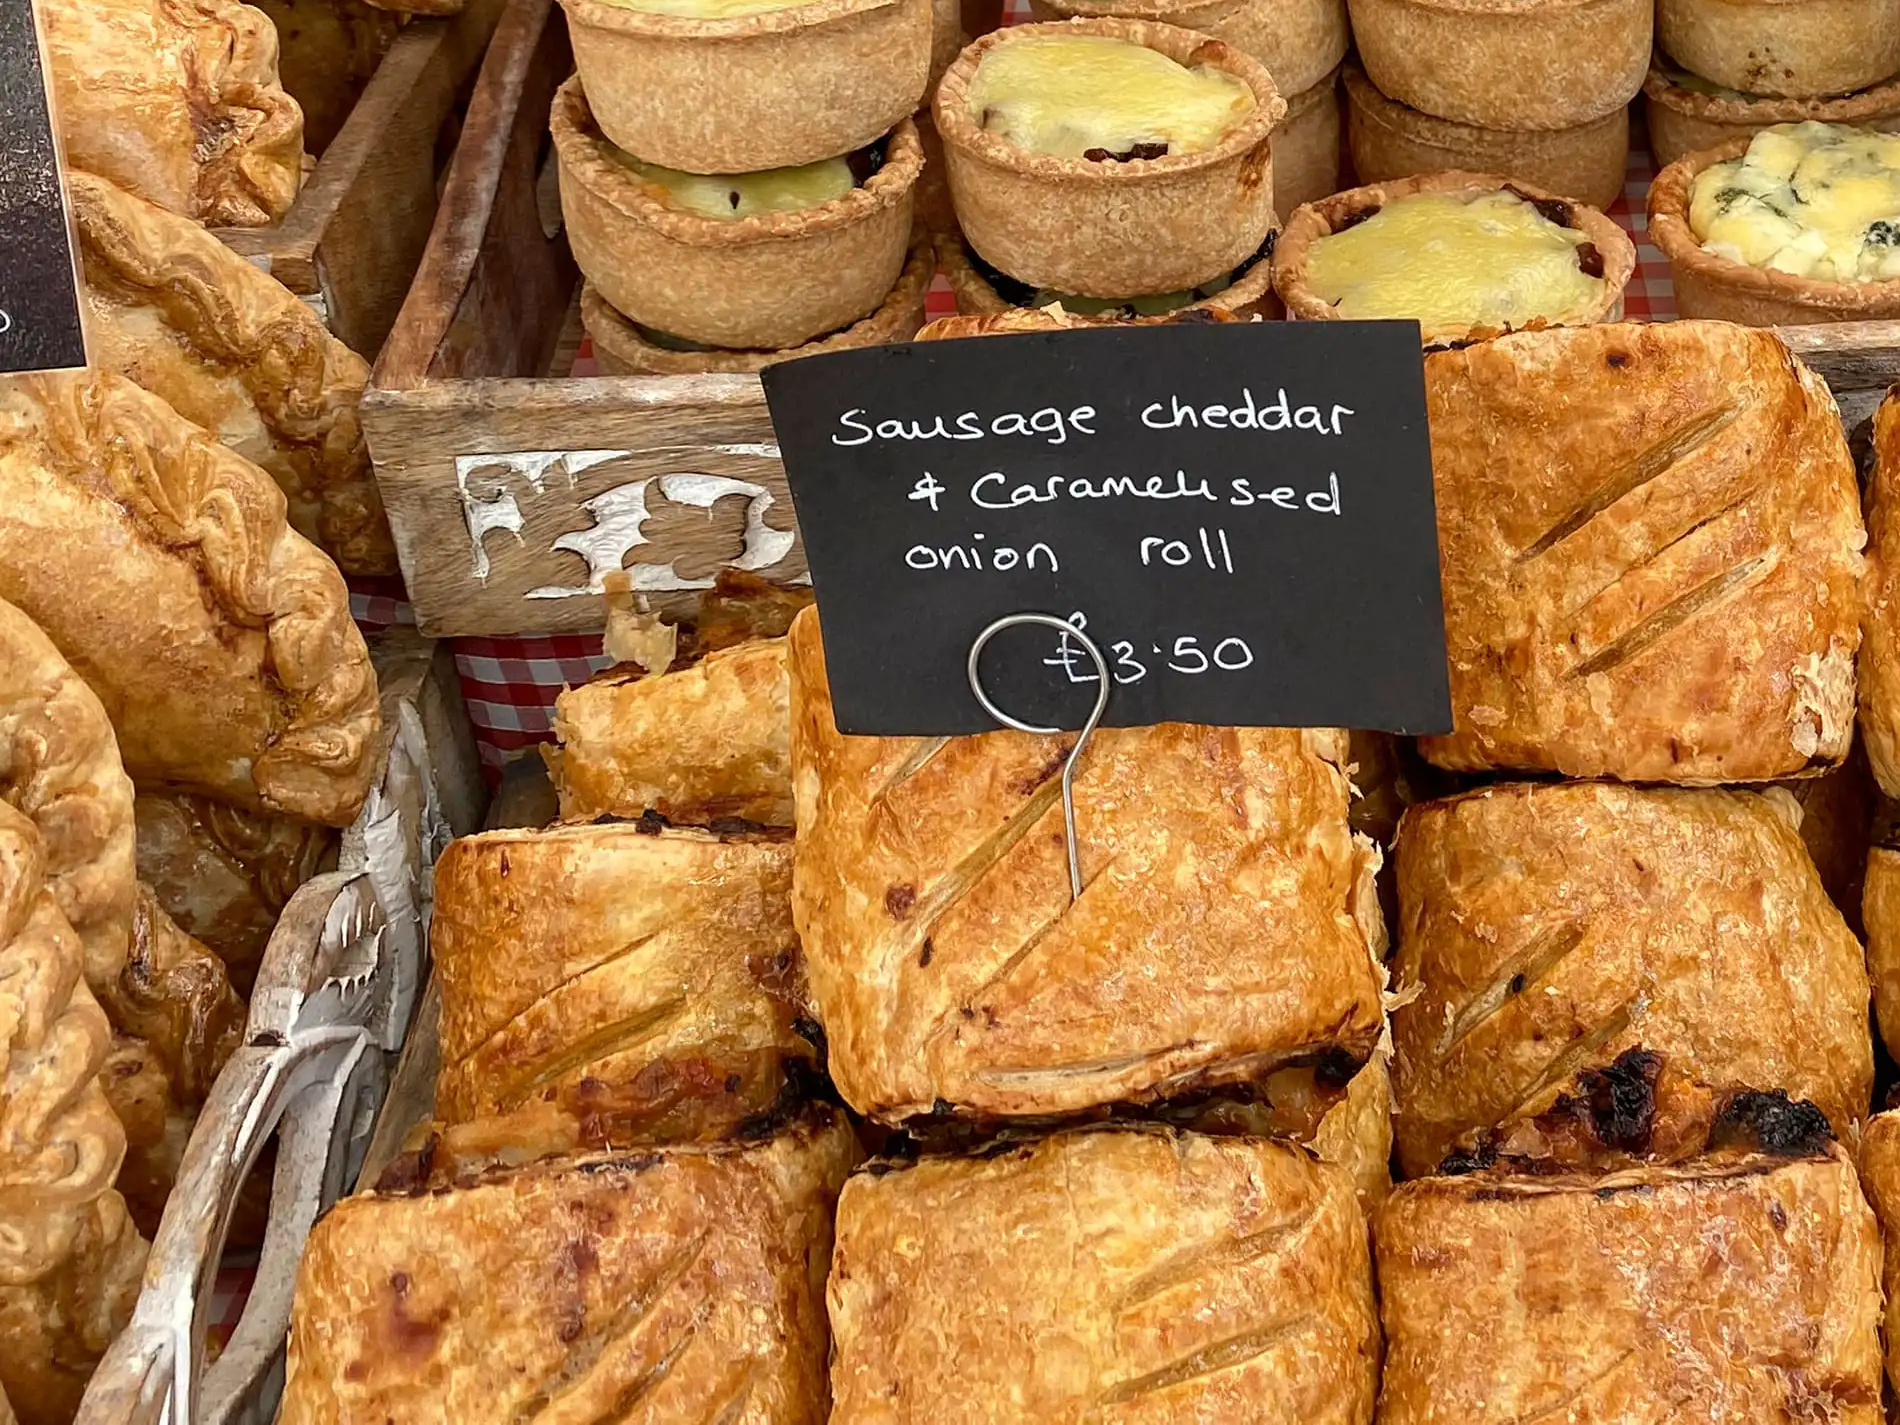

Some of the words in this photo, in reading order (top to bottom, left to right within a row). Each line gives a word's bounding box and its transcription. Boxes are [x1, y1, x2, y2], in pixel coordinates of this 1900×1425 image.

[831, 402, 1097, 447] Sausage
[1140, 387, 1355, 437] cheddar
[904, 530, 1059, 575] onion
[1139, 526, 1234, 575] roll
